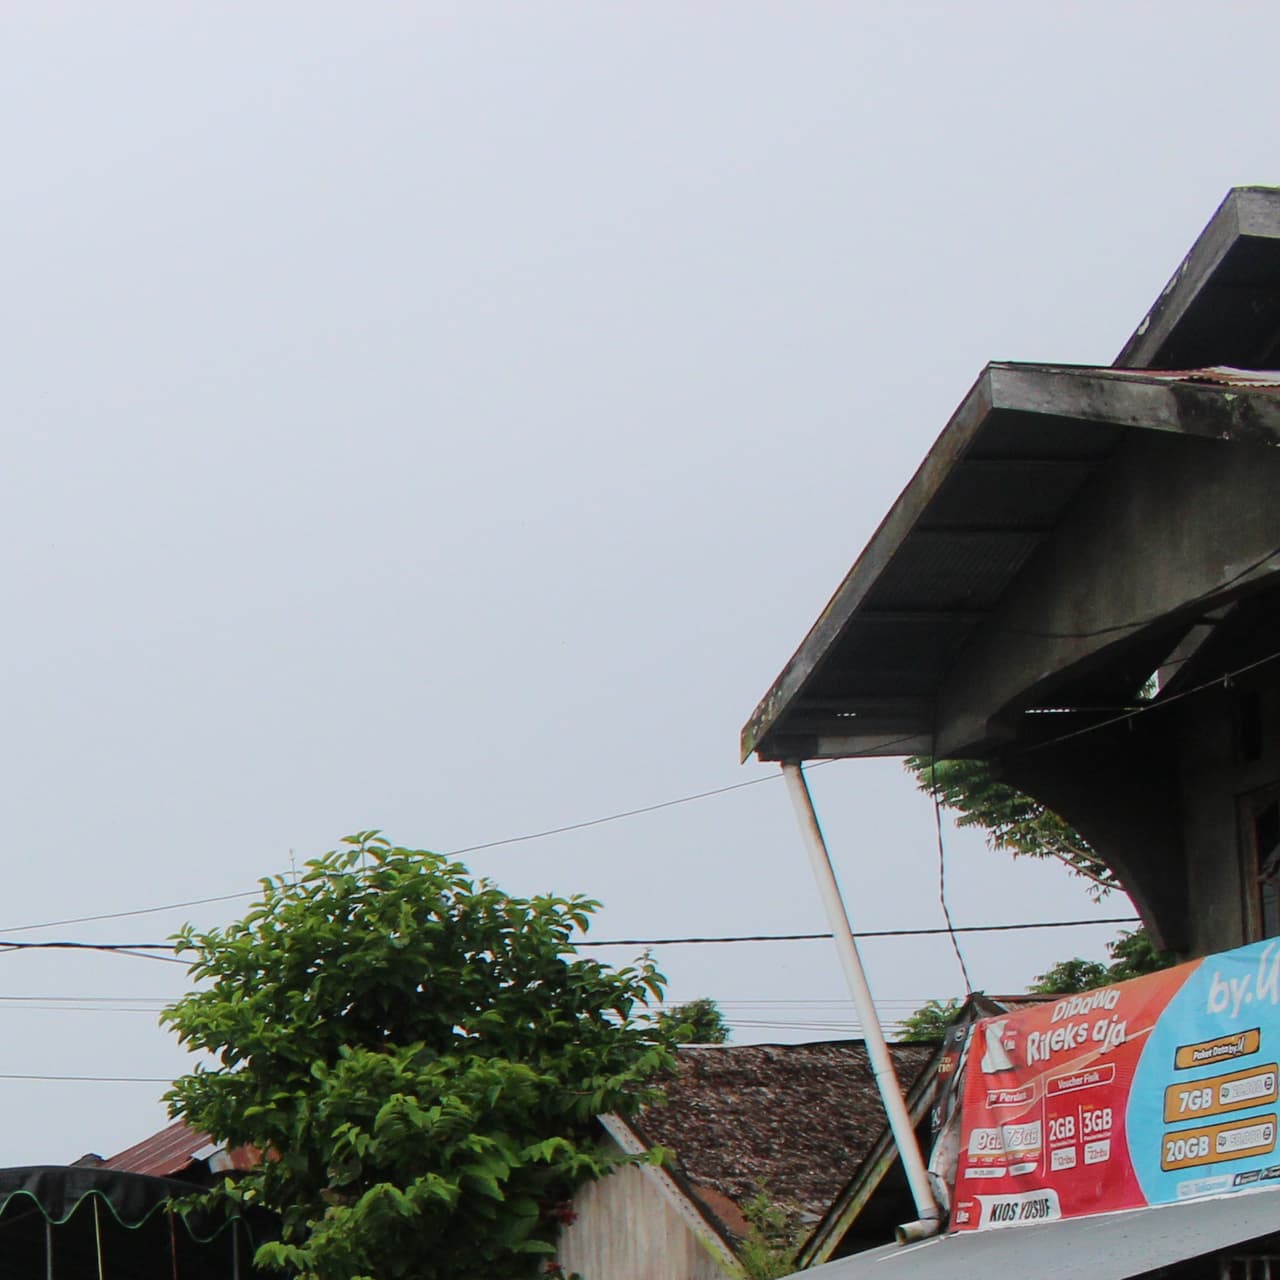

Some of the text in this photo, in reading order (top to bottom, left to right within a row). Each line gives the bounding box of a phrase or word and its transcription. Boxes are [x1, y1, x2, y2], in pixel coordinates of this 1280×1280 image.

[1051, 989, 1120, 1023] Dibawa
[1027, 1015, 1127, 1066] Rileks aja
[1179, 1088, 1212, 1113] 7GB
[1048, 1116, 1075, 1141] 2GB
[1083, 1108, 1113, 1133] 3GB
[1166, 1135, 1209, 1162] 20GB
[990, 1201, 1019, 1222] KIOS
